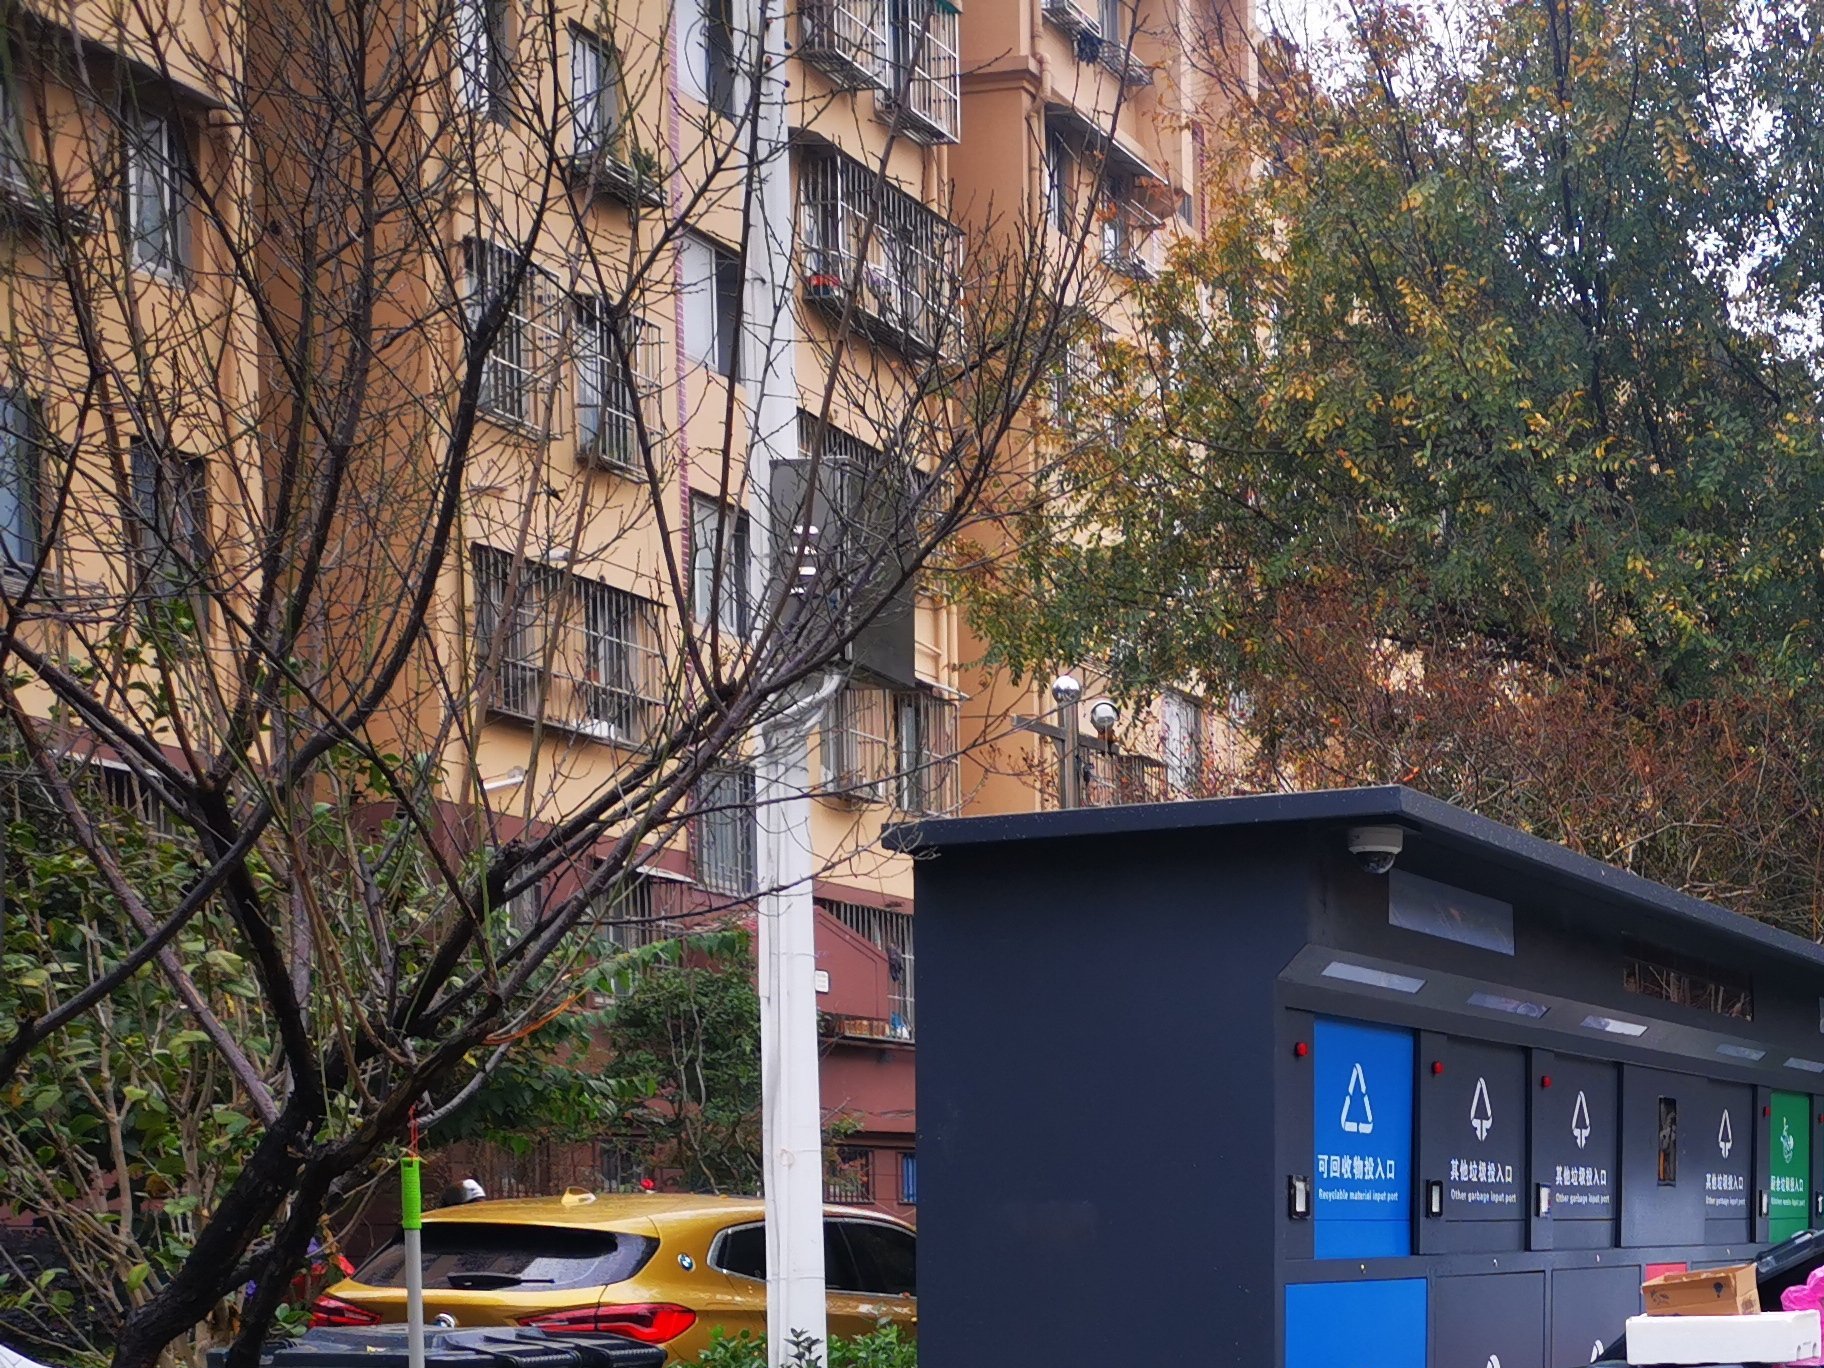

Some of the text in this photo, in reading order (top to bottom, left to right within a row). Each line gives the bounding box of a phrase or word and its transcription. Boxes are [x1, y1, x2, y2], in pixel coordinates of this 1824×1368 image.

[1317, 1154, 1395, 1180] 可回收物投入口
[1450, 1158, 1513, 1184] 其他垃圾投入口
[1555, 1165, 1607, 1187] 其他垃圾投入口
[1318, 1188, 1399, 1202] Recyclable material input port
[1450, 1189, 1467, 1200] Other
[1467, 1190, 1489, 1204] garbage
[1505, 1192, 1517, 1204] port
